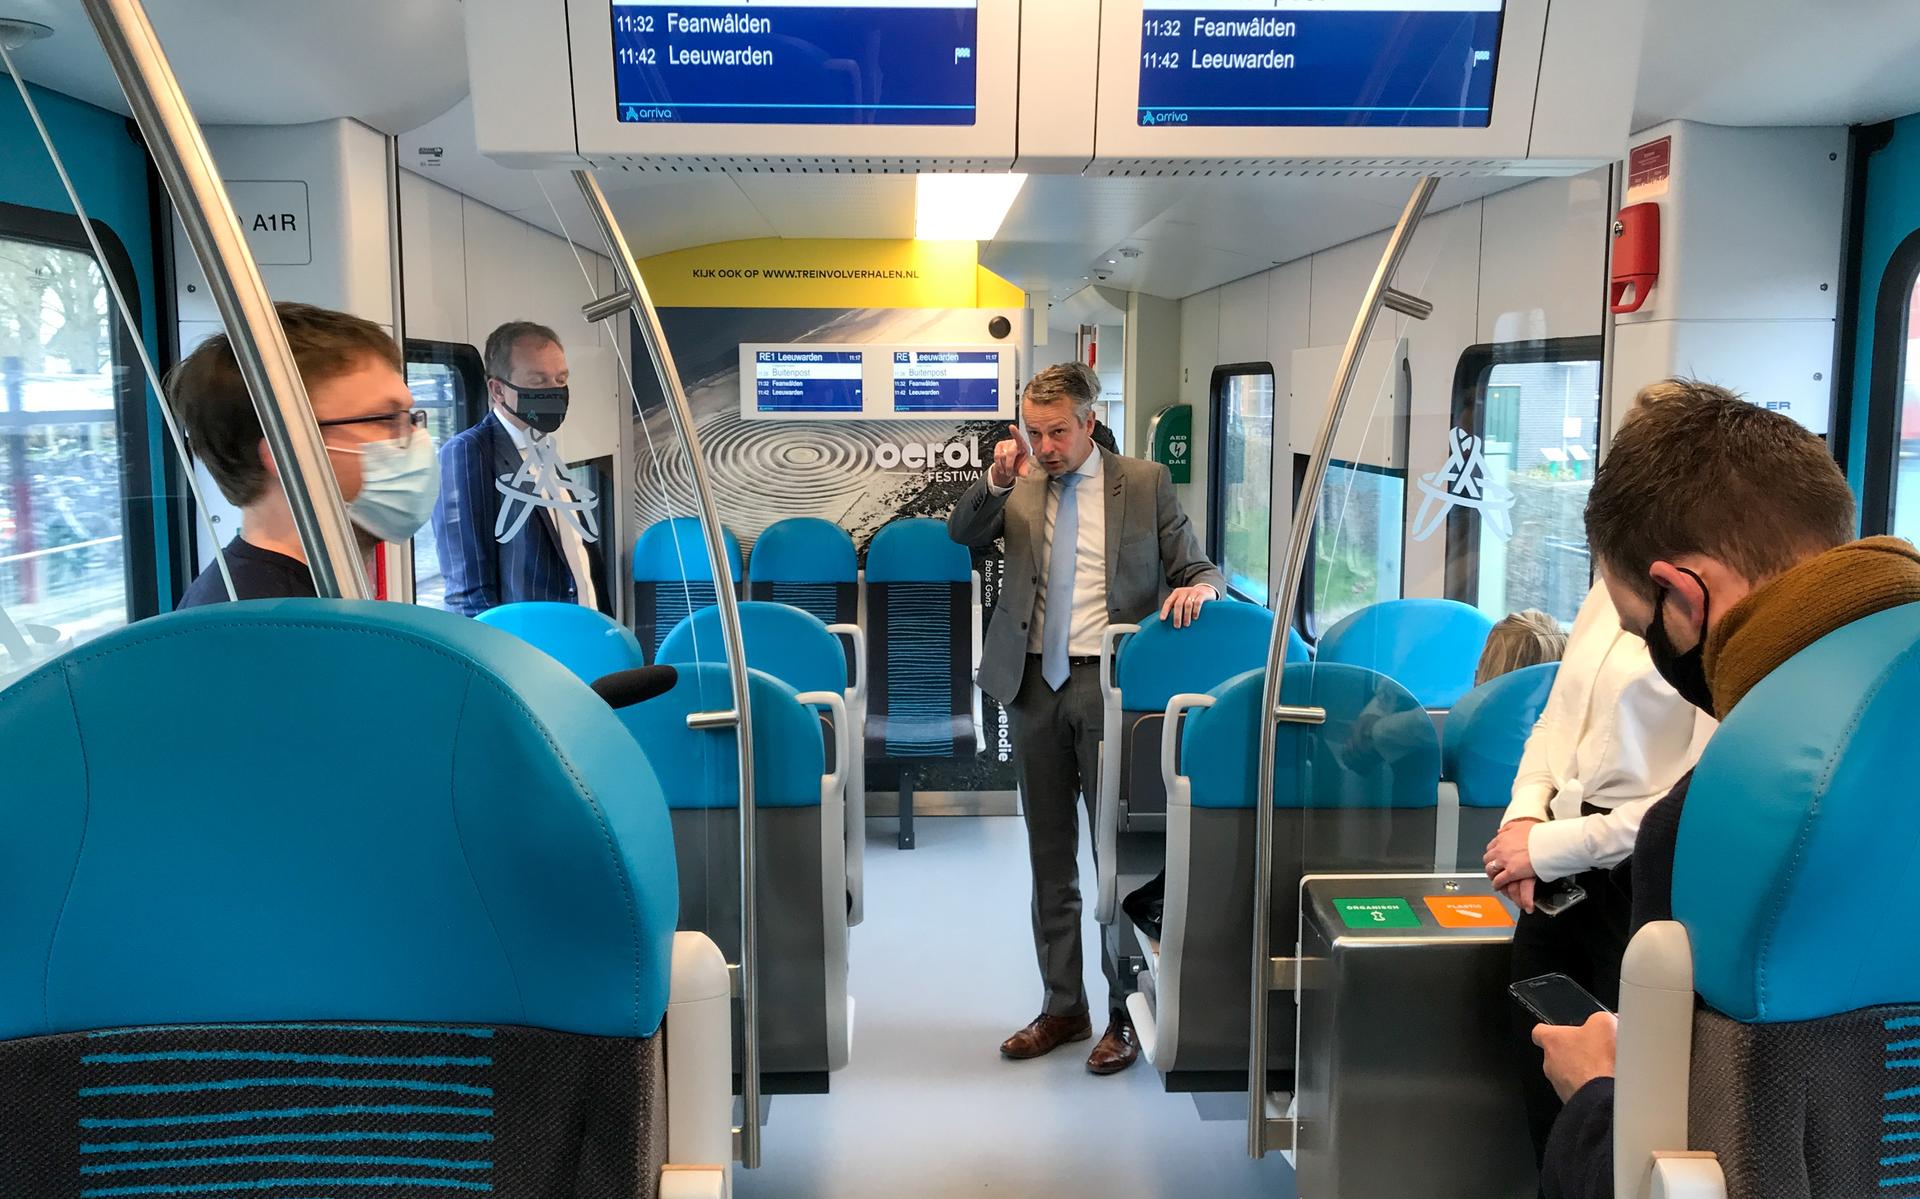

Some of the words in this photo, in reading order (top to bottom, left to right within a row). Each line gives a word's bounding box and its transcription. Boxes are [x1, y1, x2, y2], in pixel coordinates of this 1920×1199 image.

[617, 16, 654, 33] 11:32
[667, 12, 771, 34] Feanwâlden
[1144, 20, 1181, 37] 11:32
[1193, 17, 1296, 38] Feanwâlden
[619, 48, 656, 65] 11:42
[669, 45, 773, 66] Leeuwarden
[1143, 52, 1180, 69] 11:42
[1191, 49, 1295, 70] Leeuwarden
[639, 107, 672, 118] arriva
[1156, 111, 1188, 122] arriva
[253, 213, 296, 231] A1R
[692, 269, 716, 278] KIJK
[718, 269, 742, 278] OOK
[744, 269, 759, 278] OP
[763, 269, 920, 279] WWW.TREINVOLVERHALEN.NL
[759, 352, 775, 361] RE1
[778, 352, 823, 361] Leeuwarden
[772, 367, 811, 377] Buitenpost
[908, 367, 947, 377] Buitenpost
[772, 388, 804, 396] Leeuwarden
[908, 388, 940, 396] Leeuwarden
[875, 435, 983, 469] oerol
[984, 559, 994, 582] Babs
[984, 584, 994, 608] Gons
